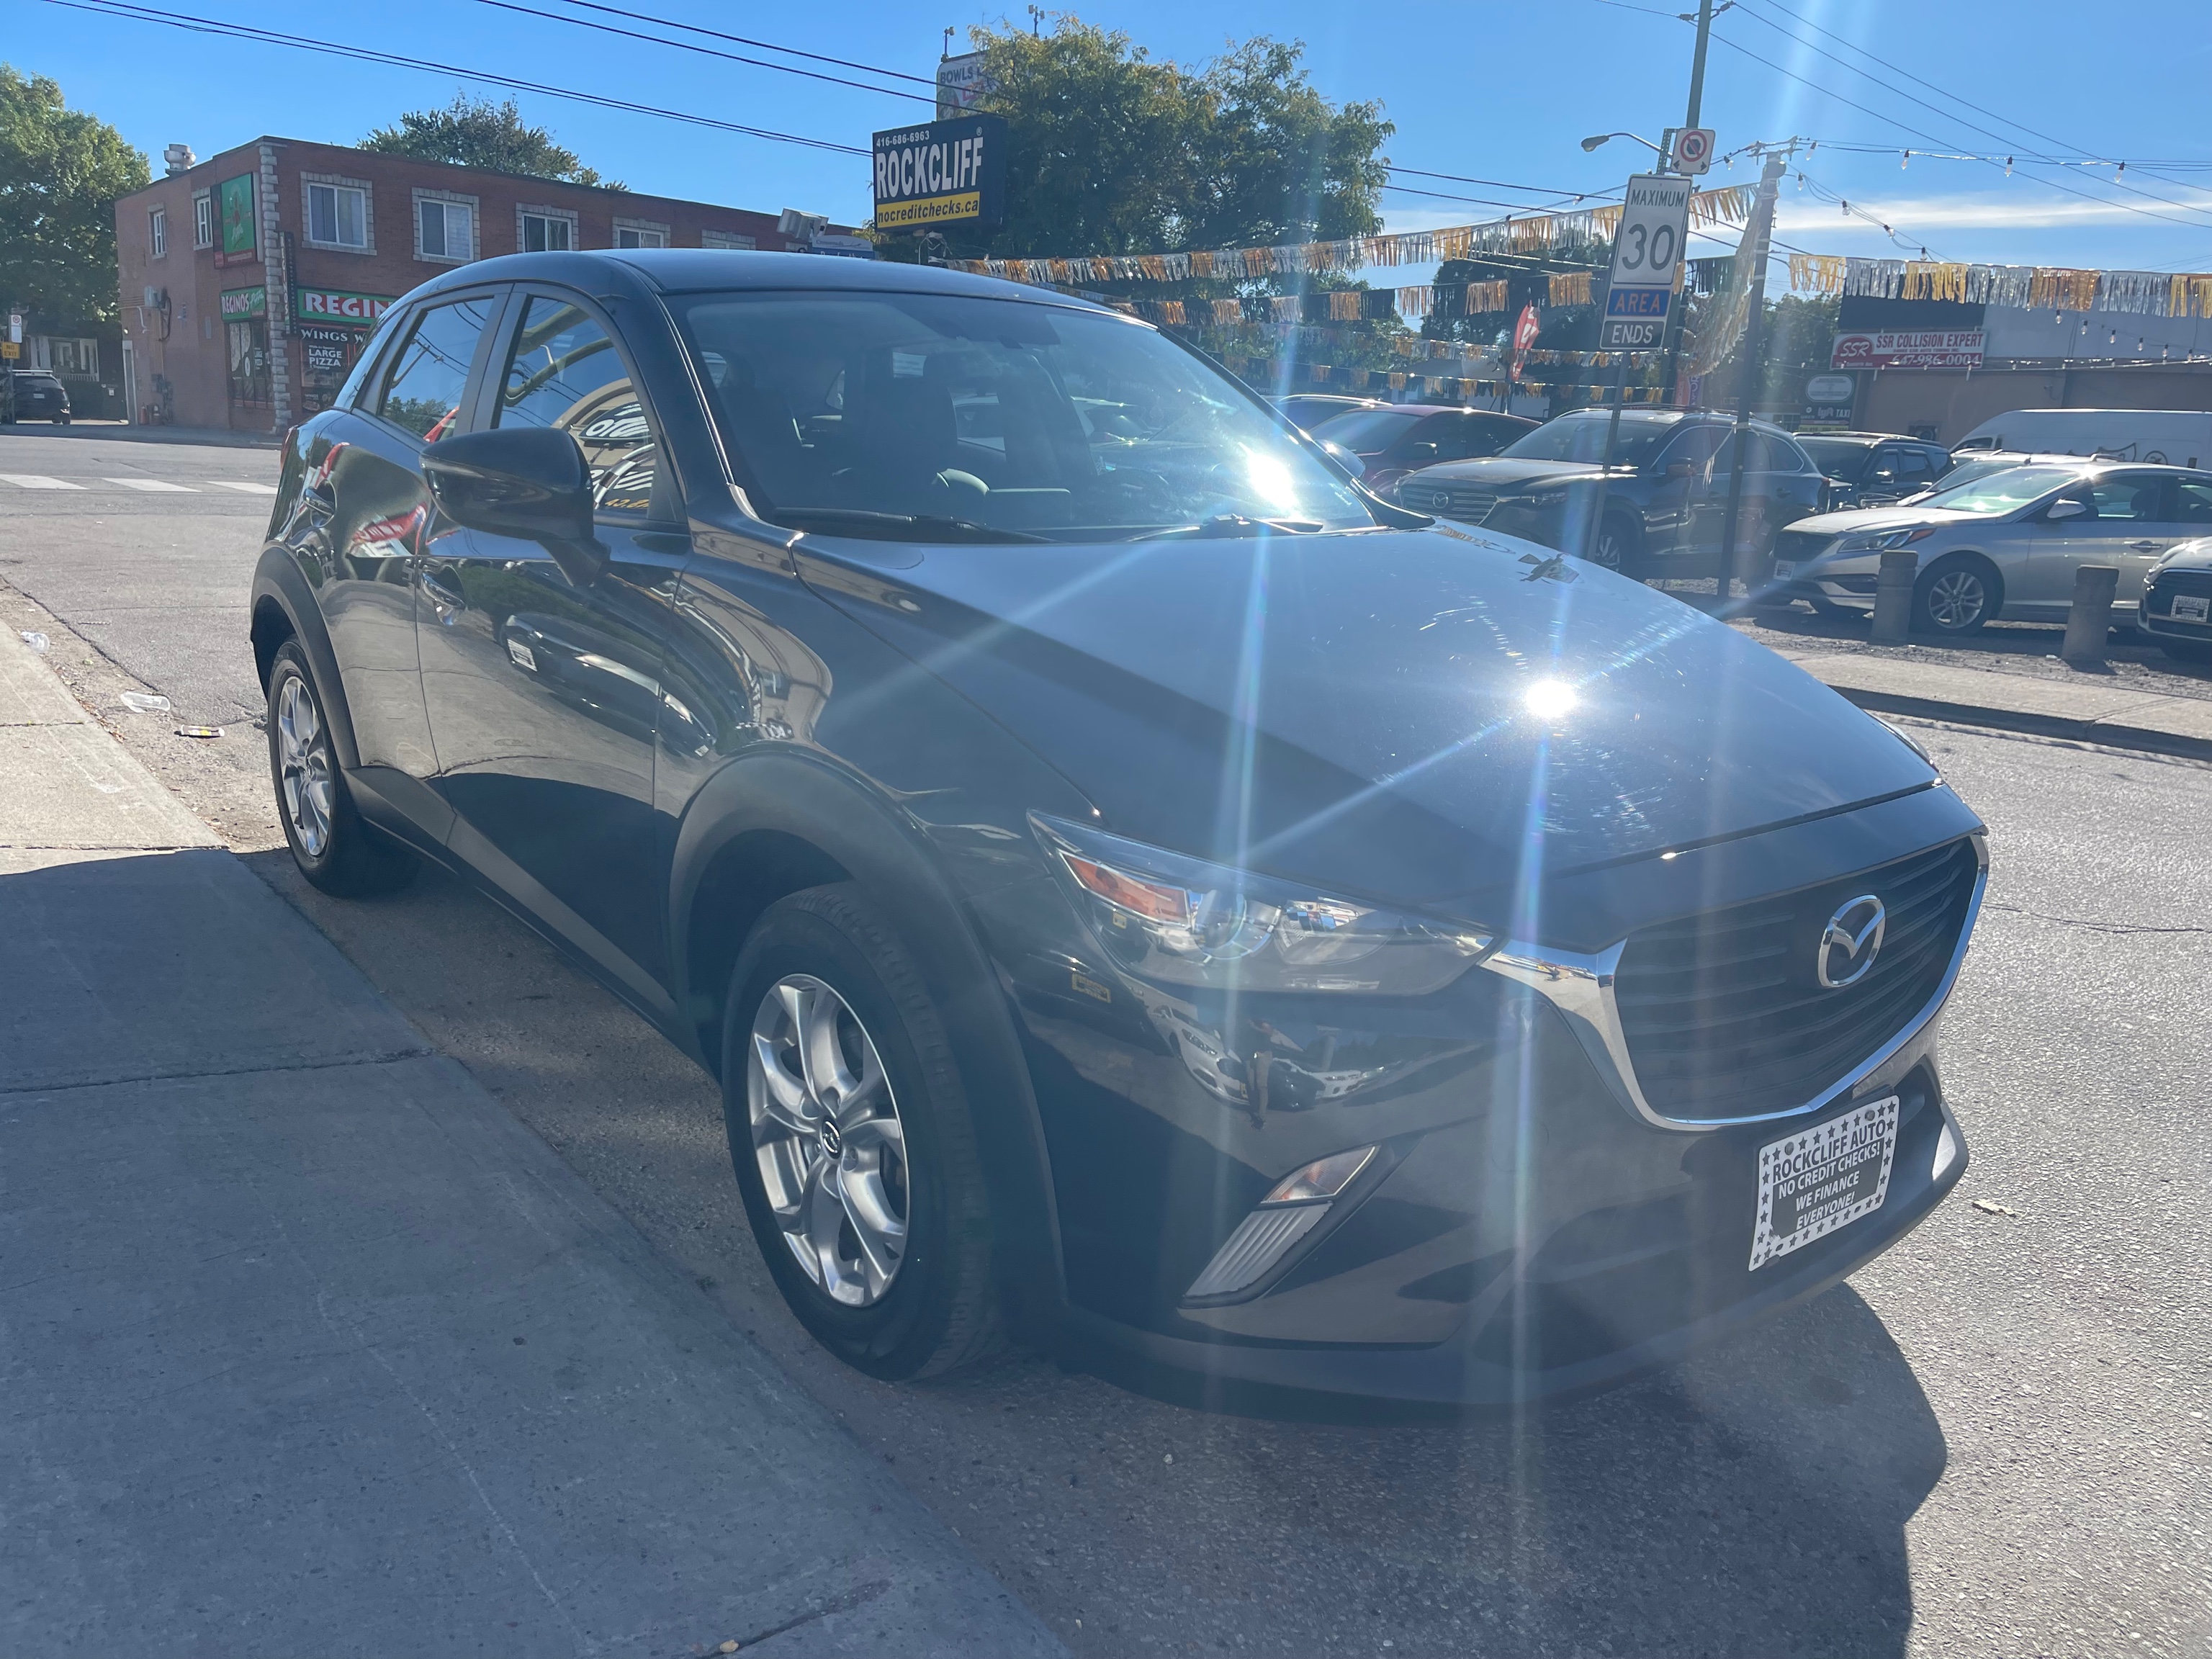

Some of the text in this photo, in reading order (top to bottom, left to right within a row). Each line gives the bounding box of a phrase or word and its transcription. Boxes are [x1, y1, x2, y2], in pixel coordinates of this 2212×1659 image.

[940, 66, 973, 84] BOWLS
[876, 130, 930, 147] 416-686-6963
[876, 137, 984, 199] ROCKCLIFF
[1630, 189, 1686, 207] MAXIMUM
[878, 199, 979, 223] nocreditchecks.ca
[1622, 224, 1676, 271] 30
[221, 293, 250, 313] REGINOS
[1614, 294, 1660, 313] AREA
[301, 328, 348, 342] WINGS
[1611, 325, 1654, 343] ENDS
[1876, 333, 1984, 349] SSR COLLISION EXPERT
[308, 349, 342, 359] LARGE
[1840, 341, 1871, 356] SSR
[309, 357, 341, 367] PIZZA
[1892, 354, 1981, 366] 647-986-0004
[1836, 409, 1851, 418] TAXI
[1773, 1119, 1886, 1184] ROCKCLIFF AUTO
[1779, 1142, 1880, 1200] NO CREDIT CHECKS!
[1796, 1171, 1860, 1212] WE FINANCE
[1796, 1191, 1856, 1231] EVERYONE!
